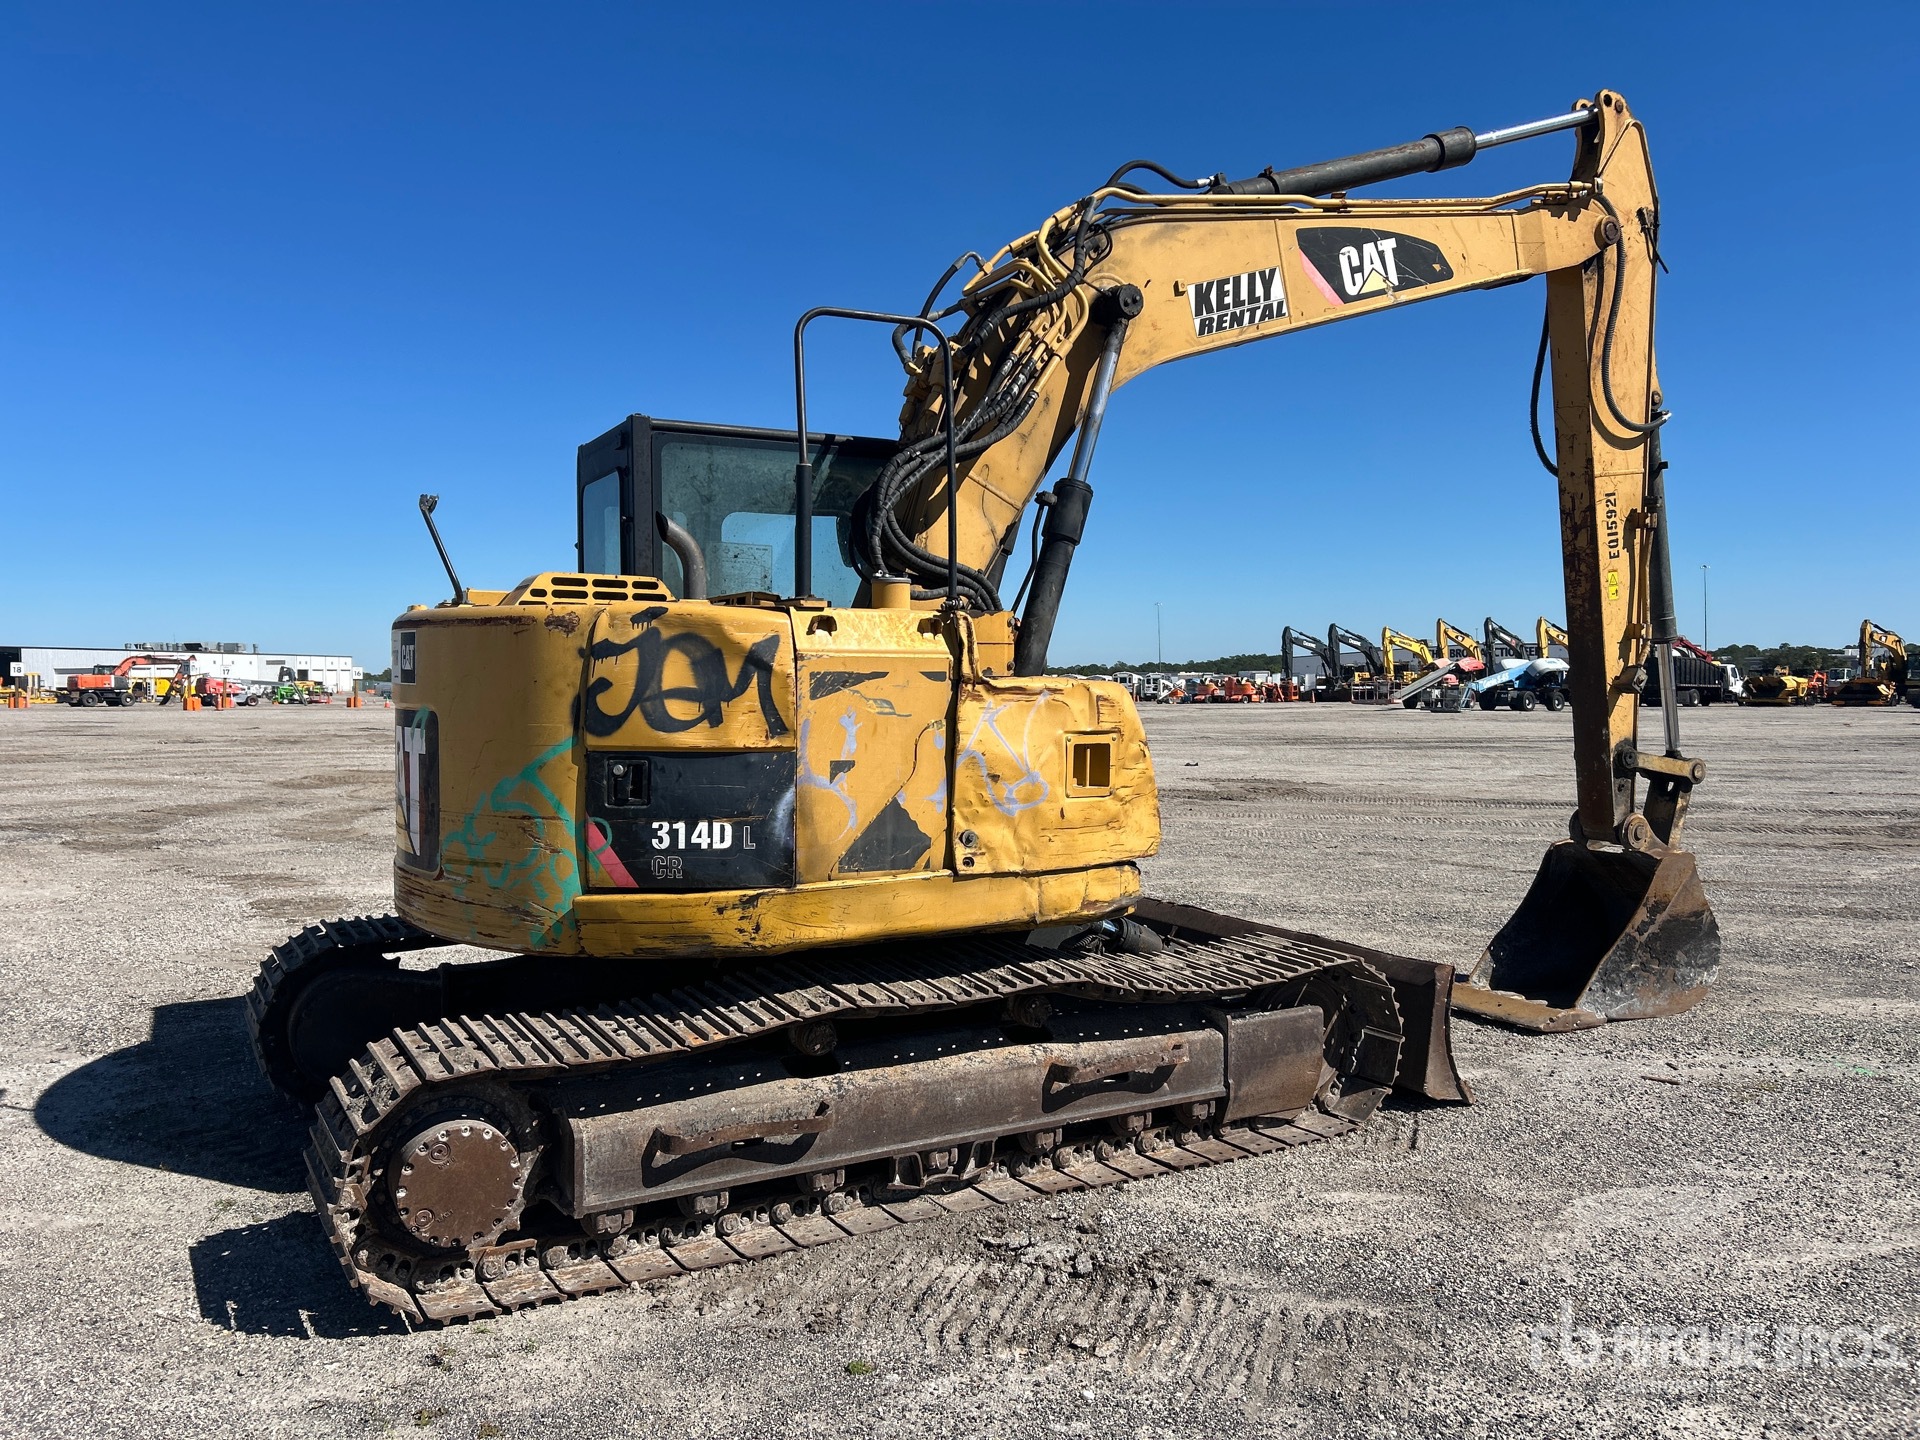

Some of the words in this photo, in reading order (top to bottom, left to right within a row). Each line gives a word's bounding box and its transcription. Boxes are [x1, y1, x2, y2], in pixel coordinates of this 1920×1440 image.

[1339, 238, 1398, 295] CAT
[1194, 267, 1279, 317] KELLY
[1198, 300, 1286, 336] RENTAL
[1604, 491, 1620, 559] EQ15921
[401, 644, 415, 670] CAT
[1450, 648, 1469, 658] BRO
[651, 820, 733, 850] 314D
[743, 825, 756, 849] L
[651, 855, 683, 879] CR
